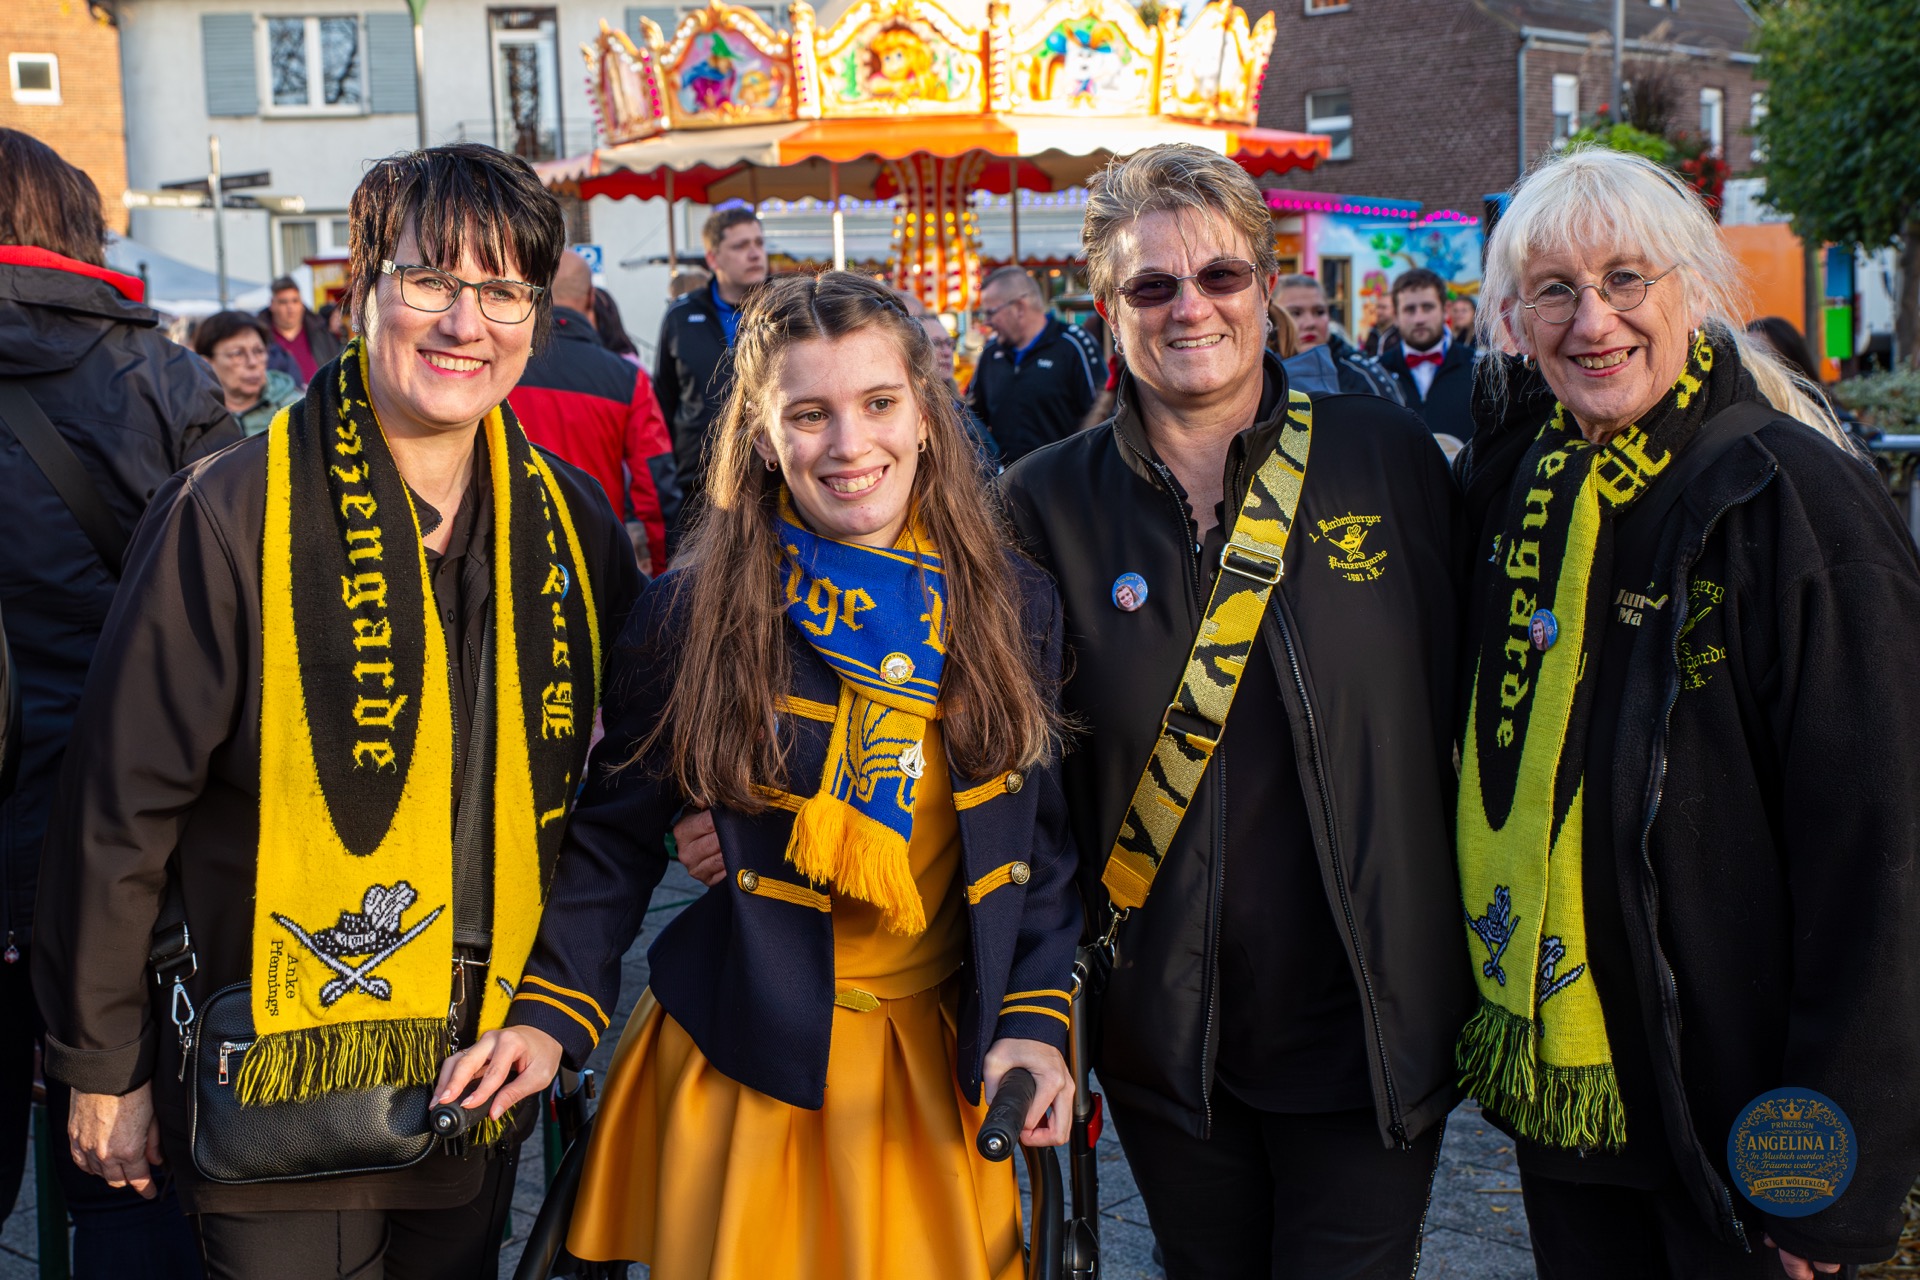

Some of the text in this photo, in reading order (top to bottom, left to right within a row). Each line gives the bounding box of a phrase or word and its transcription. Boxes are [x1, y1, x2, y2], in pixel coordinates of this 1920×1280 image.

[1317, 511, 1382, 538] Bardenberger
[1328, 550, 1388, 570] Prinzengarde
[1614, 589, 1646, 609] Jun
[1618, 607, 1643, 627] Ma
[265, 940, 284, 1017] Pfennings
[285, 953, 301, 999] Anke
